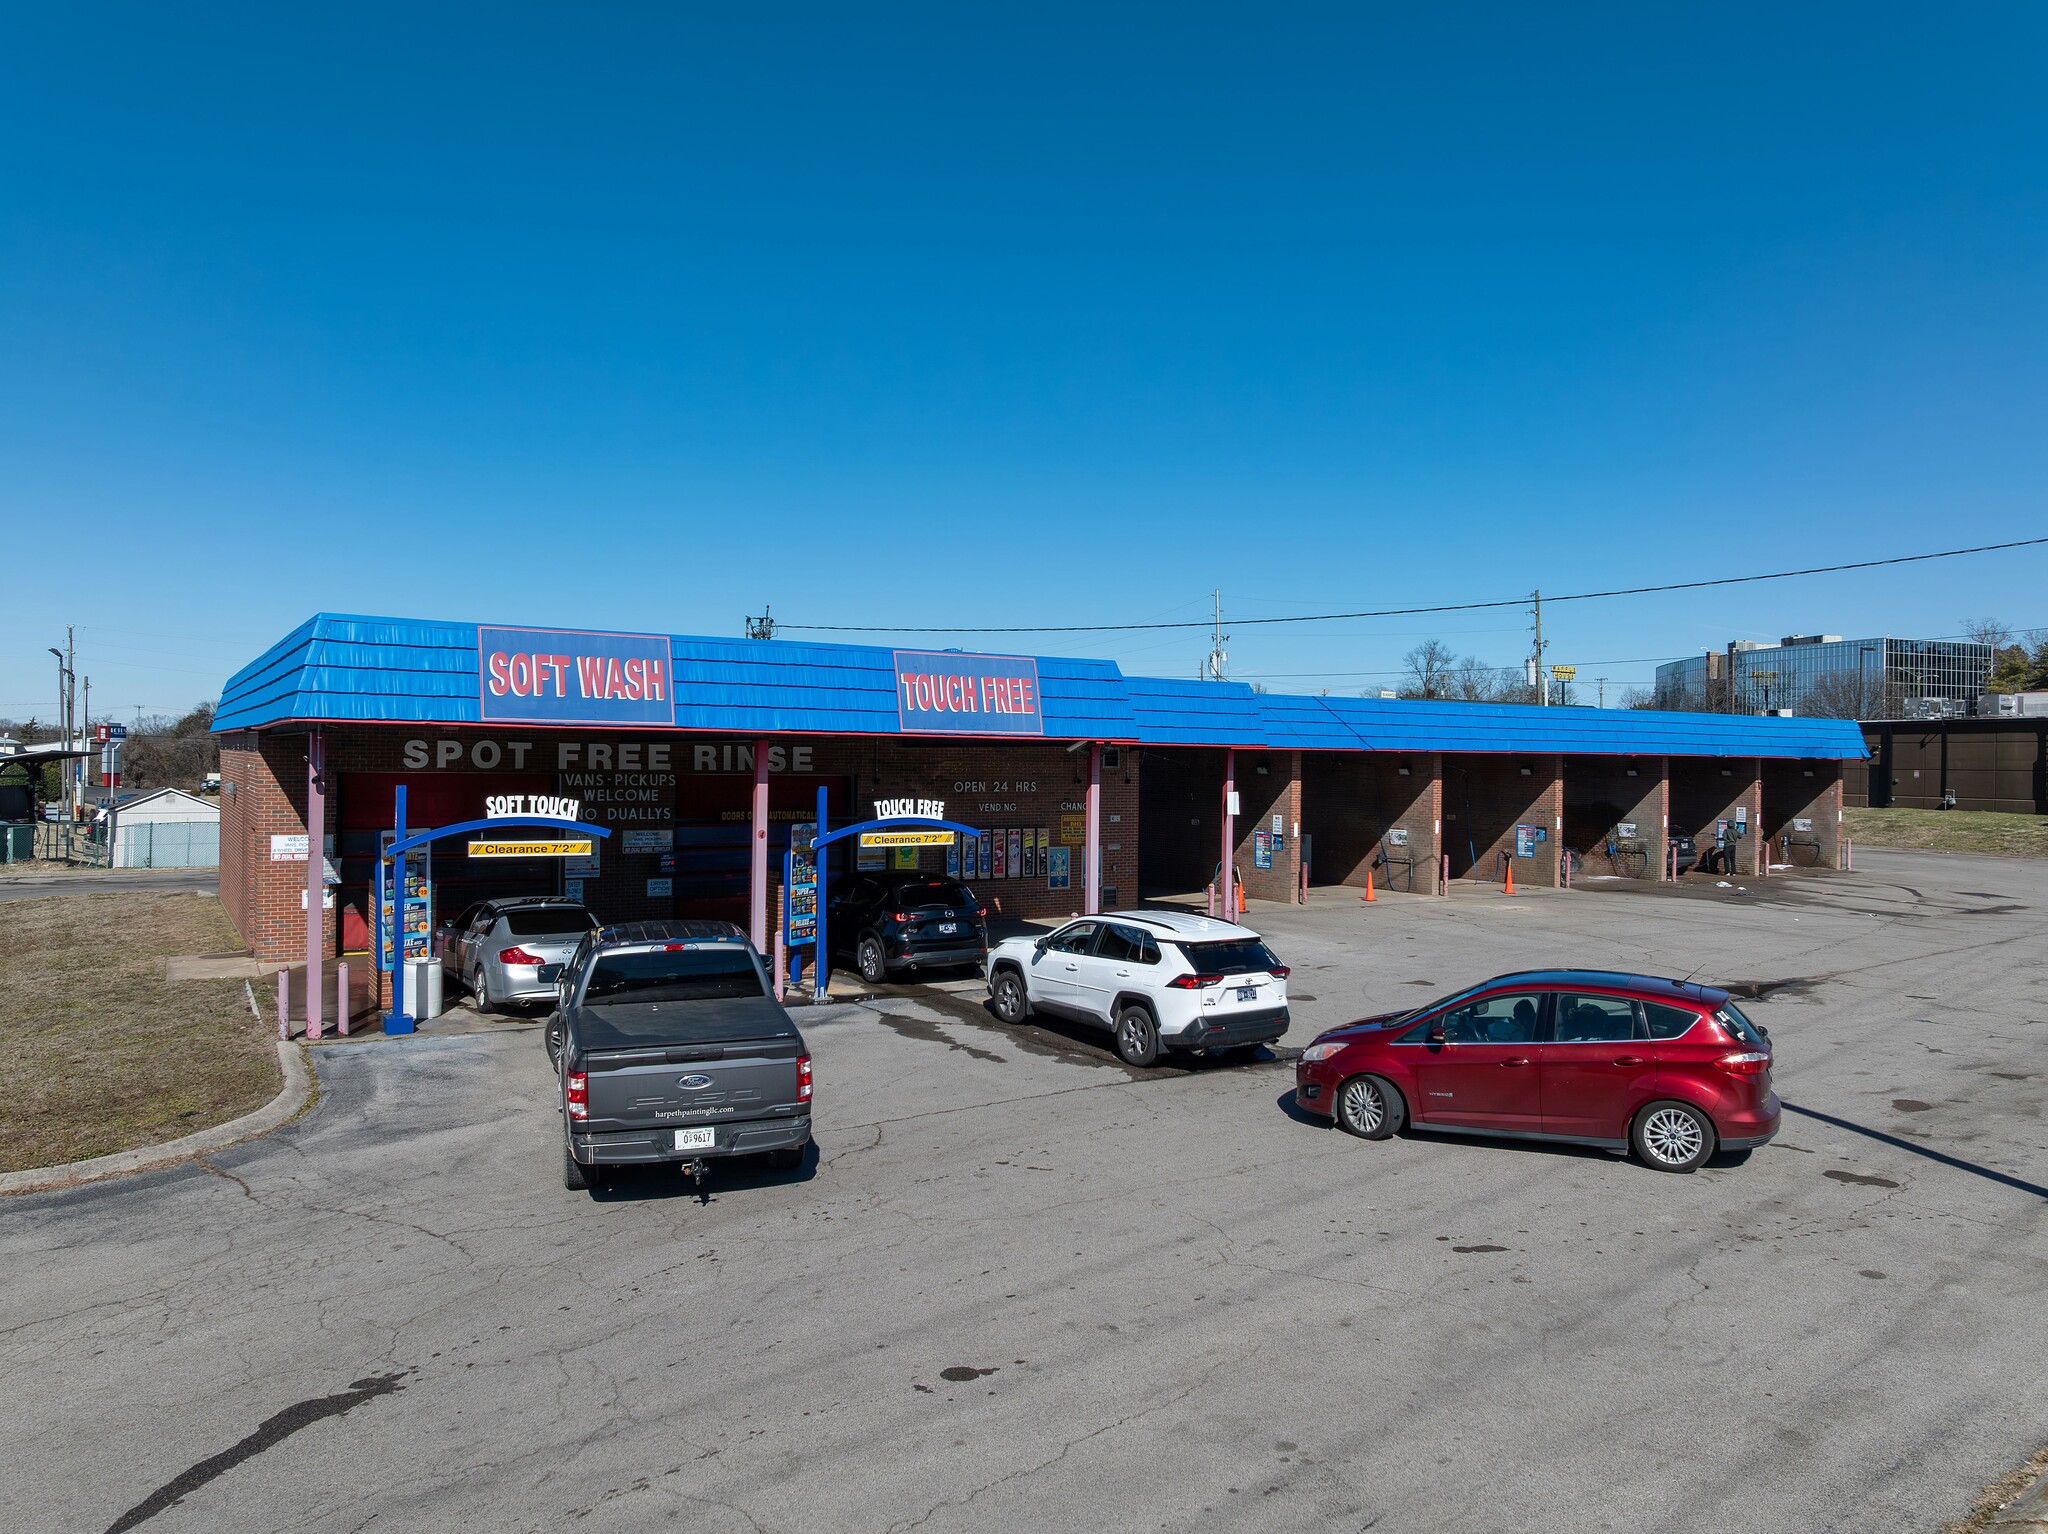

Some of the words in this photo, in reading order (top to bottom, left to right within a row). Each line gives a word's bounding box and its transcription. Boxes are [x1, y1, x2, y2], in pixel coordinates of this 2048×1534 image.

[489, 652, 570, 697] SOFT
[576, 656, 665, 701] WASH
[901, 673, 978, 712] TOUCH
[981, 677, 1035, 714] FREE
[402, 740, 533, 769] SPOT
[558, 742, 672, 770] FREE
[694, 744, 813, 771] RINSE
[954, 781, 986, 792] OPEN
[993, 781, 1009, 792] 24
[1016, 781, 1037, 792] HRS
[584, 789, 659, 801] WELCOME
[486, 795, 525, 817] SOFT
[528, 795, 579, 820] TOUCH
[874, 798, 914, 817] TOUCH
[917, 798, 945, 819] FREE
[979, 802, 1017, 812] VENDNG
[577, 808, 597, 820] NO
[607, 807, 671, 820] DUALLYS
[721, 811, 745, 820] DOORS
[874, 836, 921, 844] Clearance
[485, 845, 548, 854] Clearance
[686, 1077, 703, 1086] Ford
[655, 1106, 735, 1119] harpethpaintingllc.com
